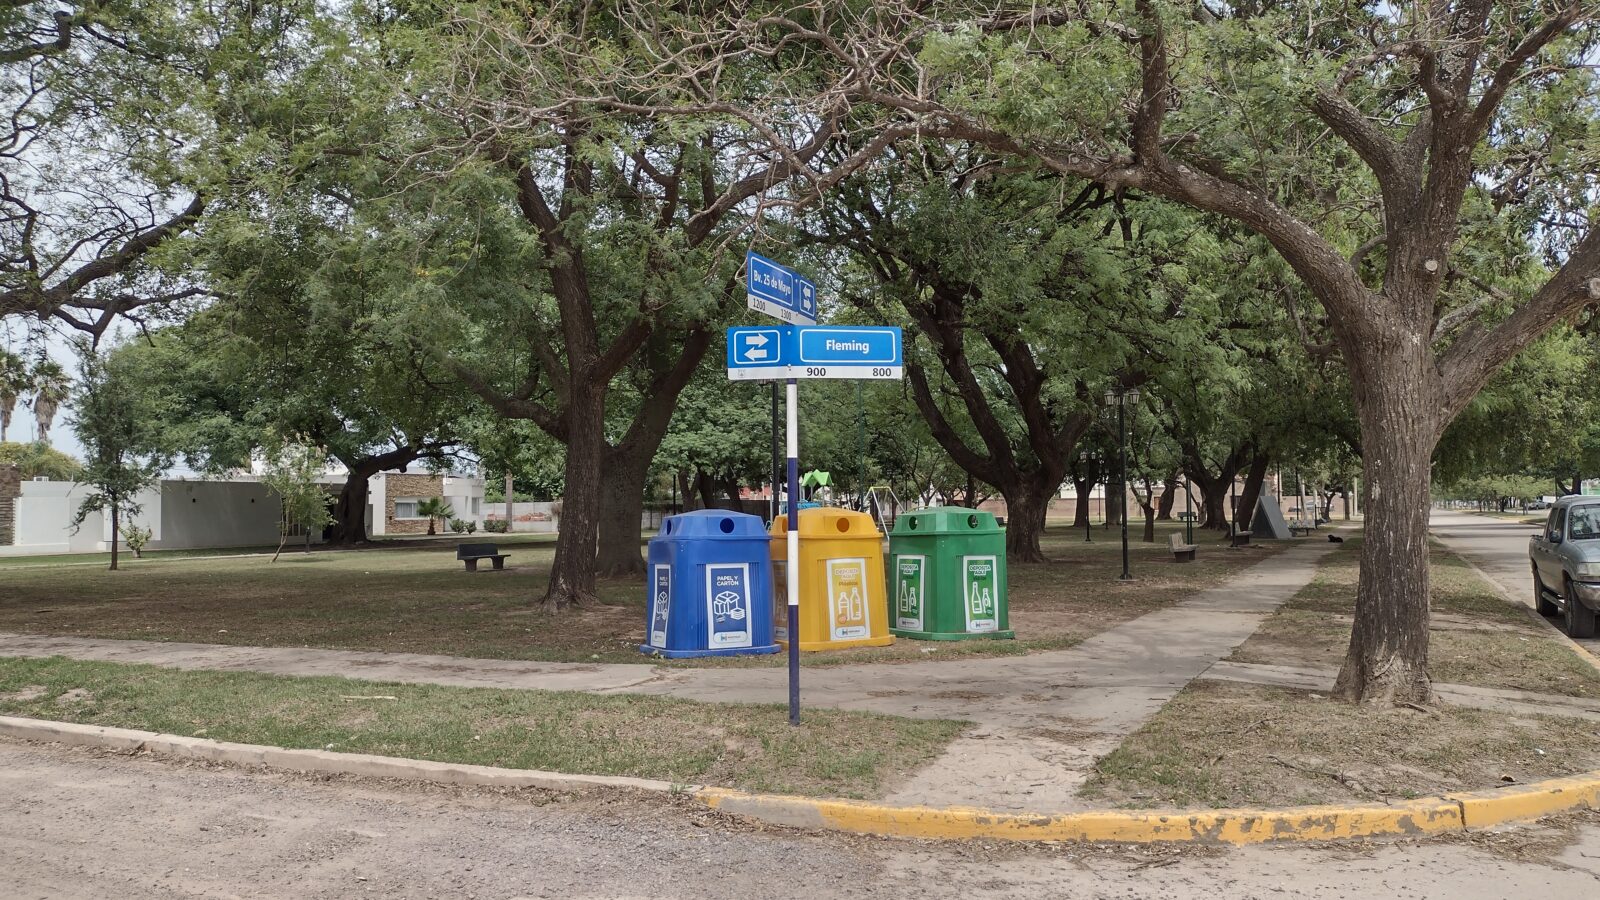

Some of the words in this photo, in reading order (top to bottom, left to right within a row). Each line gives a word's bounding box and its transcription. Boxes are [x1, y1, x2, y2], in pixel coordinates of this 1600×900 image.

[753, 269, 762, 283] Bv.
[763, 273, 770, 286] 25
[770, 276, 778, 289] de
[778, 279, 791, 296] Mayo
[753, 298, 766, 311] 1200
[780, 308, 792, 321] 1300
[826, 339, 870, 354] Fleming
[806, 367, 826, 377] 900
[872, 367, 892, 377] 800
